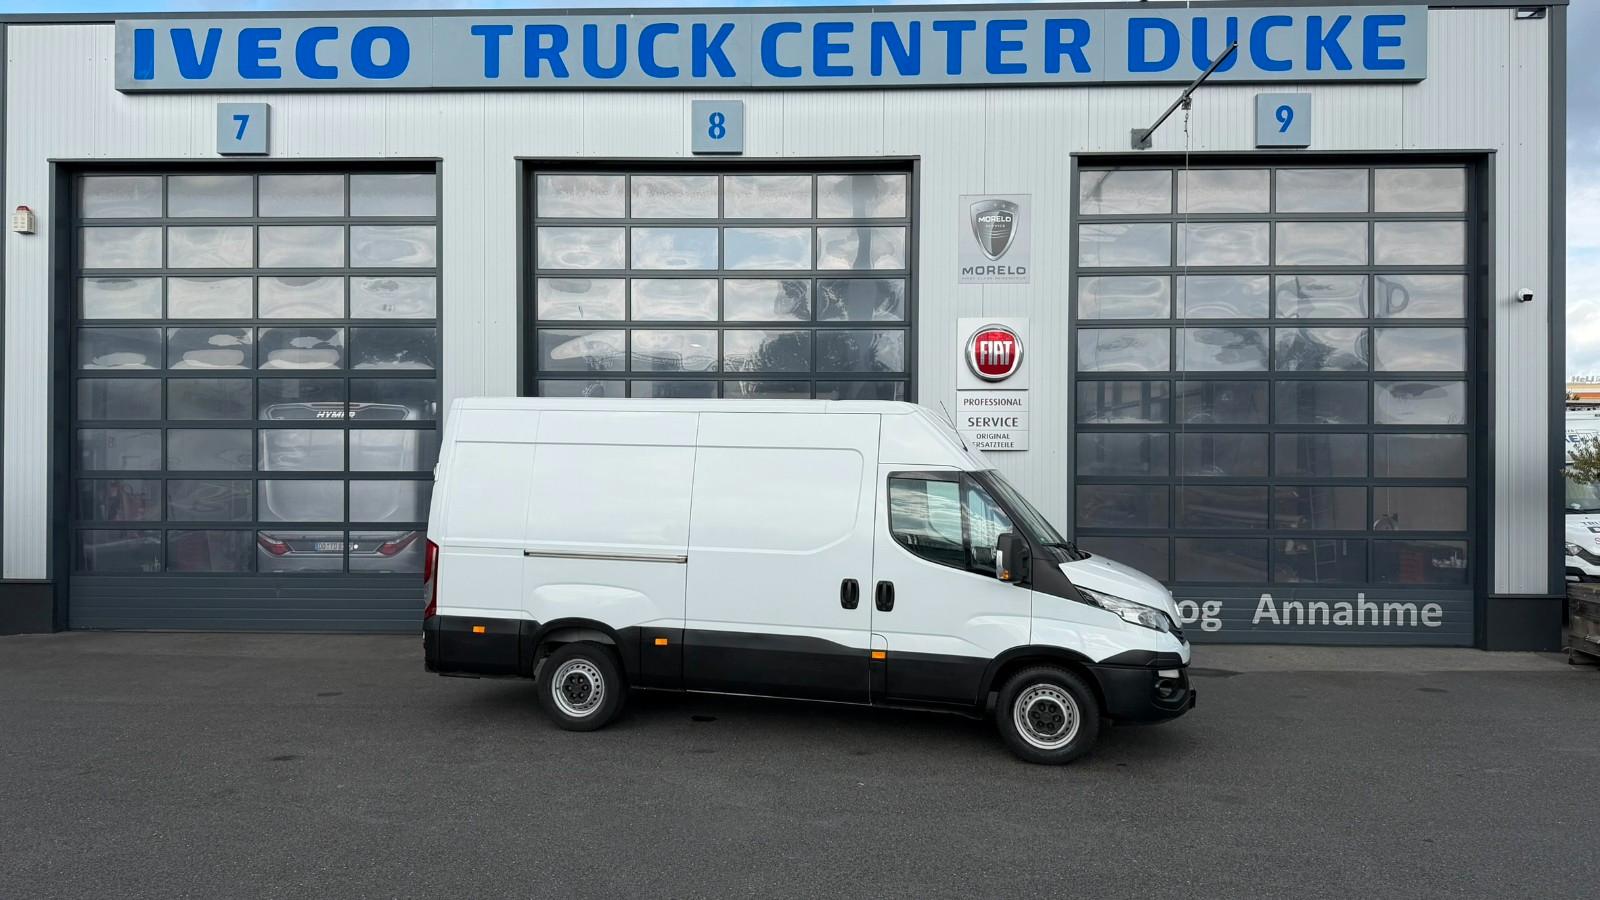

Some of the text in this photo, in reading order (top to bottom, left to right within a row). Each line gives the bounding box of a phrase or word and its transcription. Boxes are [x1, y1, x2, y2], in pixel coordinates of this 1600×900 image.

[133, 13, 1407, 81] IVECO TRUCK CENTER DUCKE
[232, 114, 251, 141] 7
[707, 112, 727, 141] 8
[1274, 104, 1295, 134] 9
[978, 215, 1012, 223] MORELO
[962, 265, 1026, 275] MORELO
[980, 340, 1012, 365] FIAT
[963, 398, 1022, 406] PROFESSIONAL
[968, 417, 1018, 427] SERVICE
[1178, 593, 1443, 632] og Annahme
